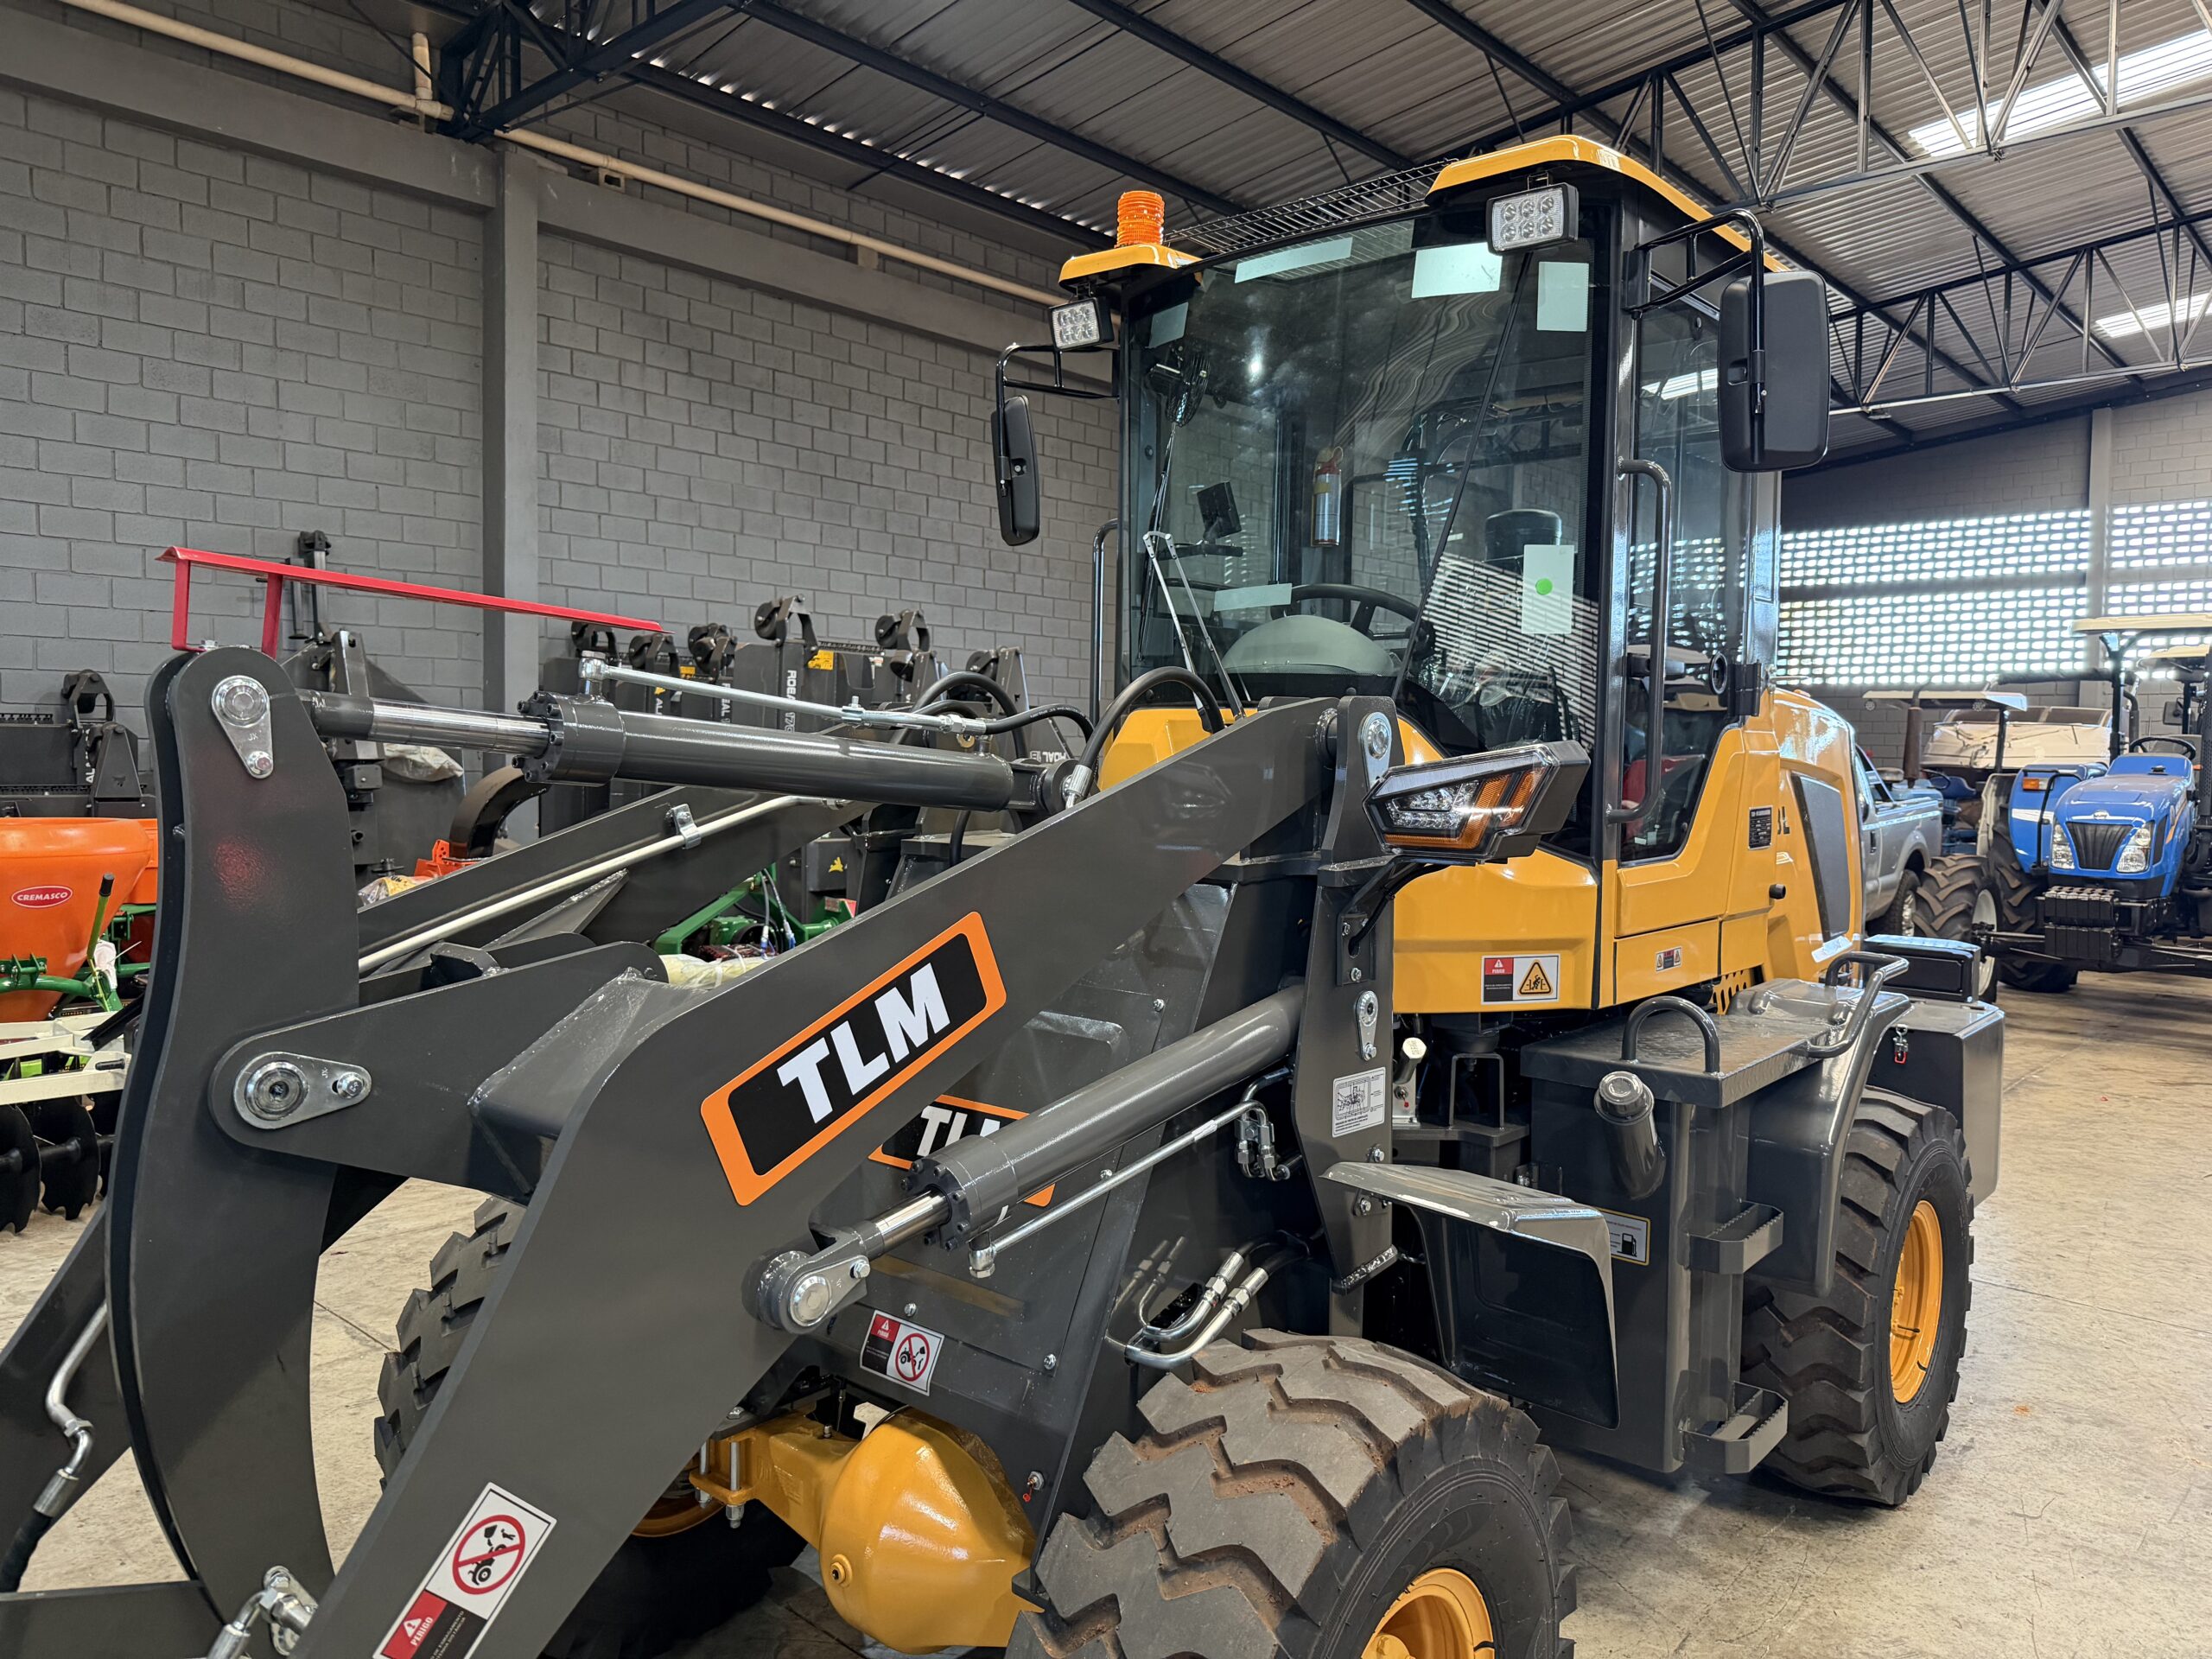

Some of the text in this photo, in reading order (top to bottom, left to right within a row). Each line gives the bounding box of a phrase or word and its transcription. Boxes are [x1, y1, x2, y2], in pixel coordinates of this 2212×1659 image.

[16, 892, 68, 901] CREMASCO
[777, 962, 950, 1123] TLM
[410, 1616, 434, 1646] PERIGO
